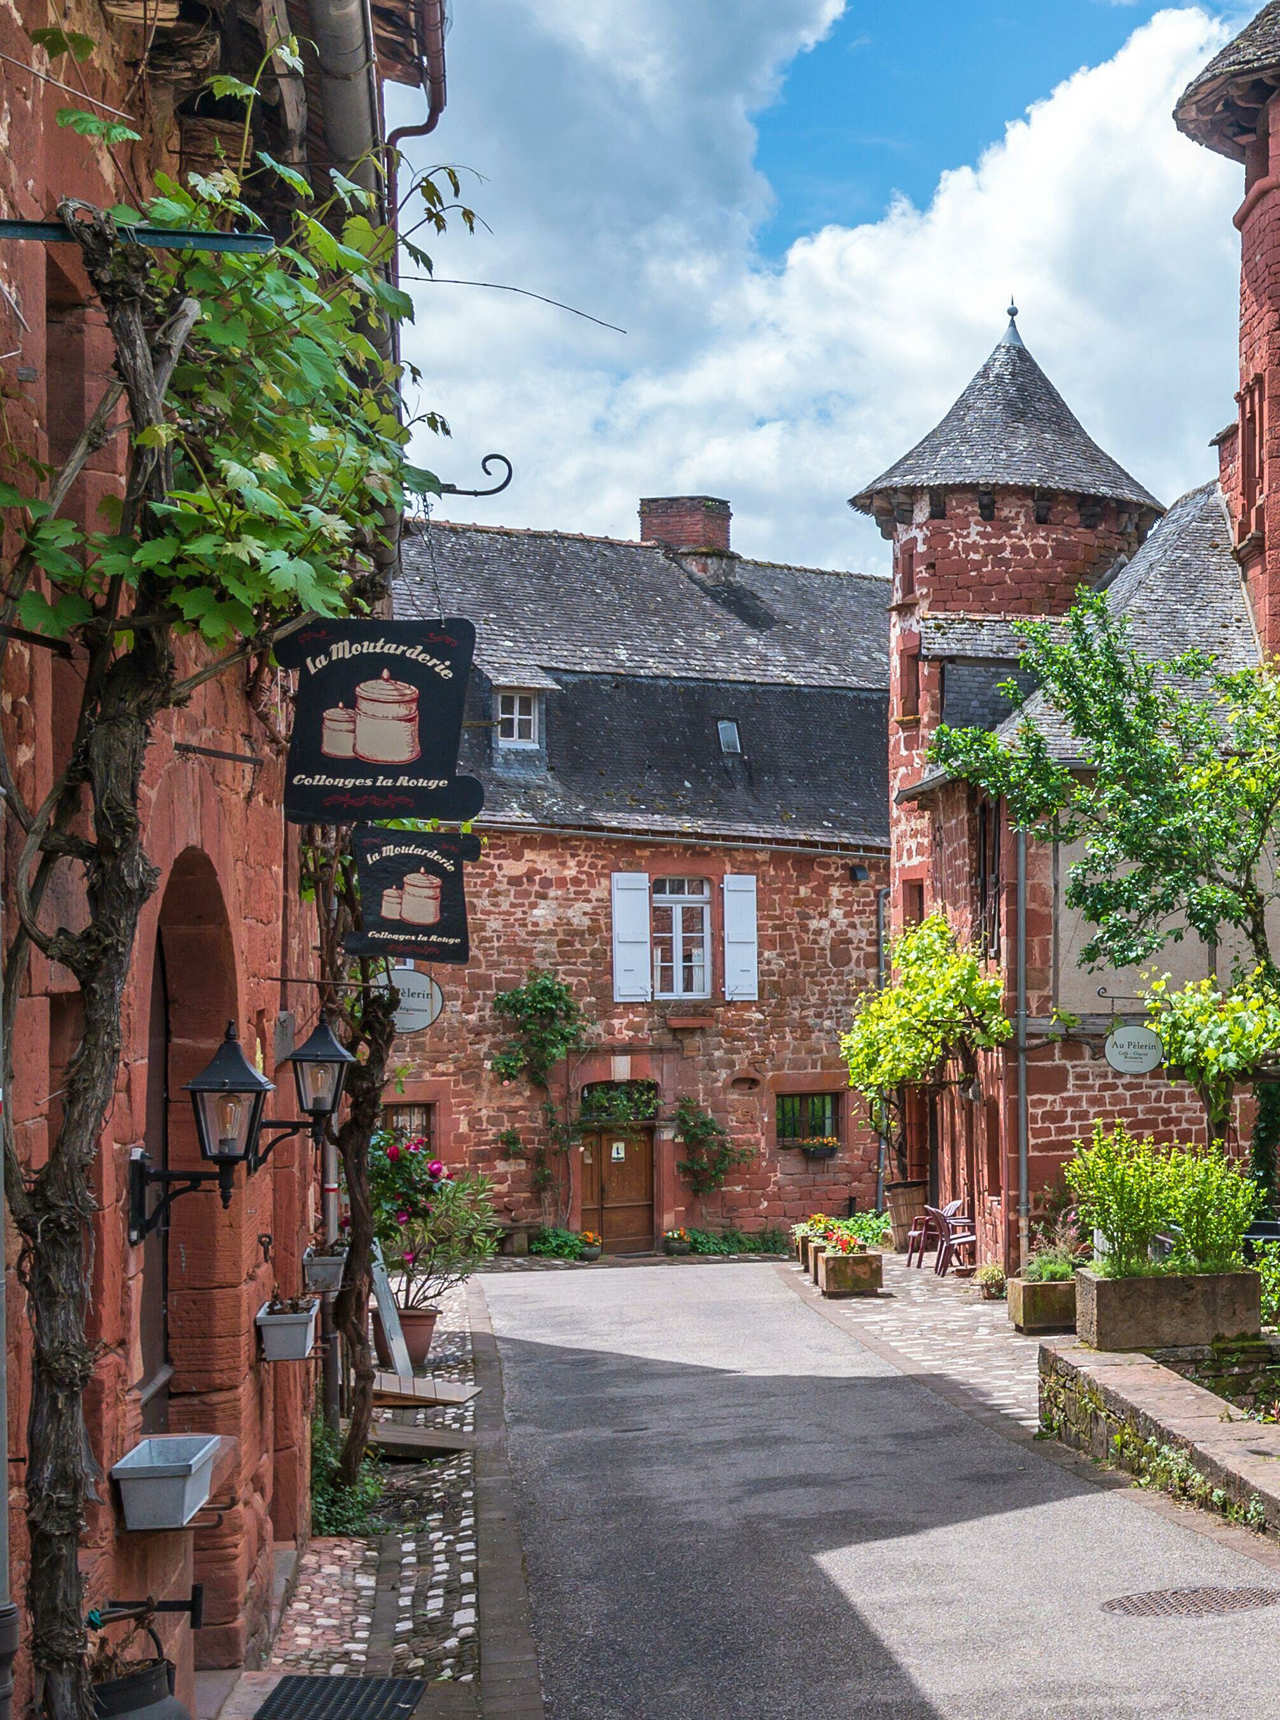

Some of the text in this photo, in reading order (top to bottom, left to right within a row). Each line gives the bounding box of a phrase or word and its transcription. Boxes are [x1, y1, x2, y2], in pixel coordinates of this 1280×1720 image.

[329, 638, 454, 680] Moutarderie
[292, 774, 449, 789] Collonges la Rouge
[381, 844, 455, 872] Moutarderie
[367, 931, 416, 941] Collonges
[429, 935, 462, 945] Rouge
[399, 987, 433, 1000] èlerin
[1111, 1041, 1157, 1050] Au Pèlerin
